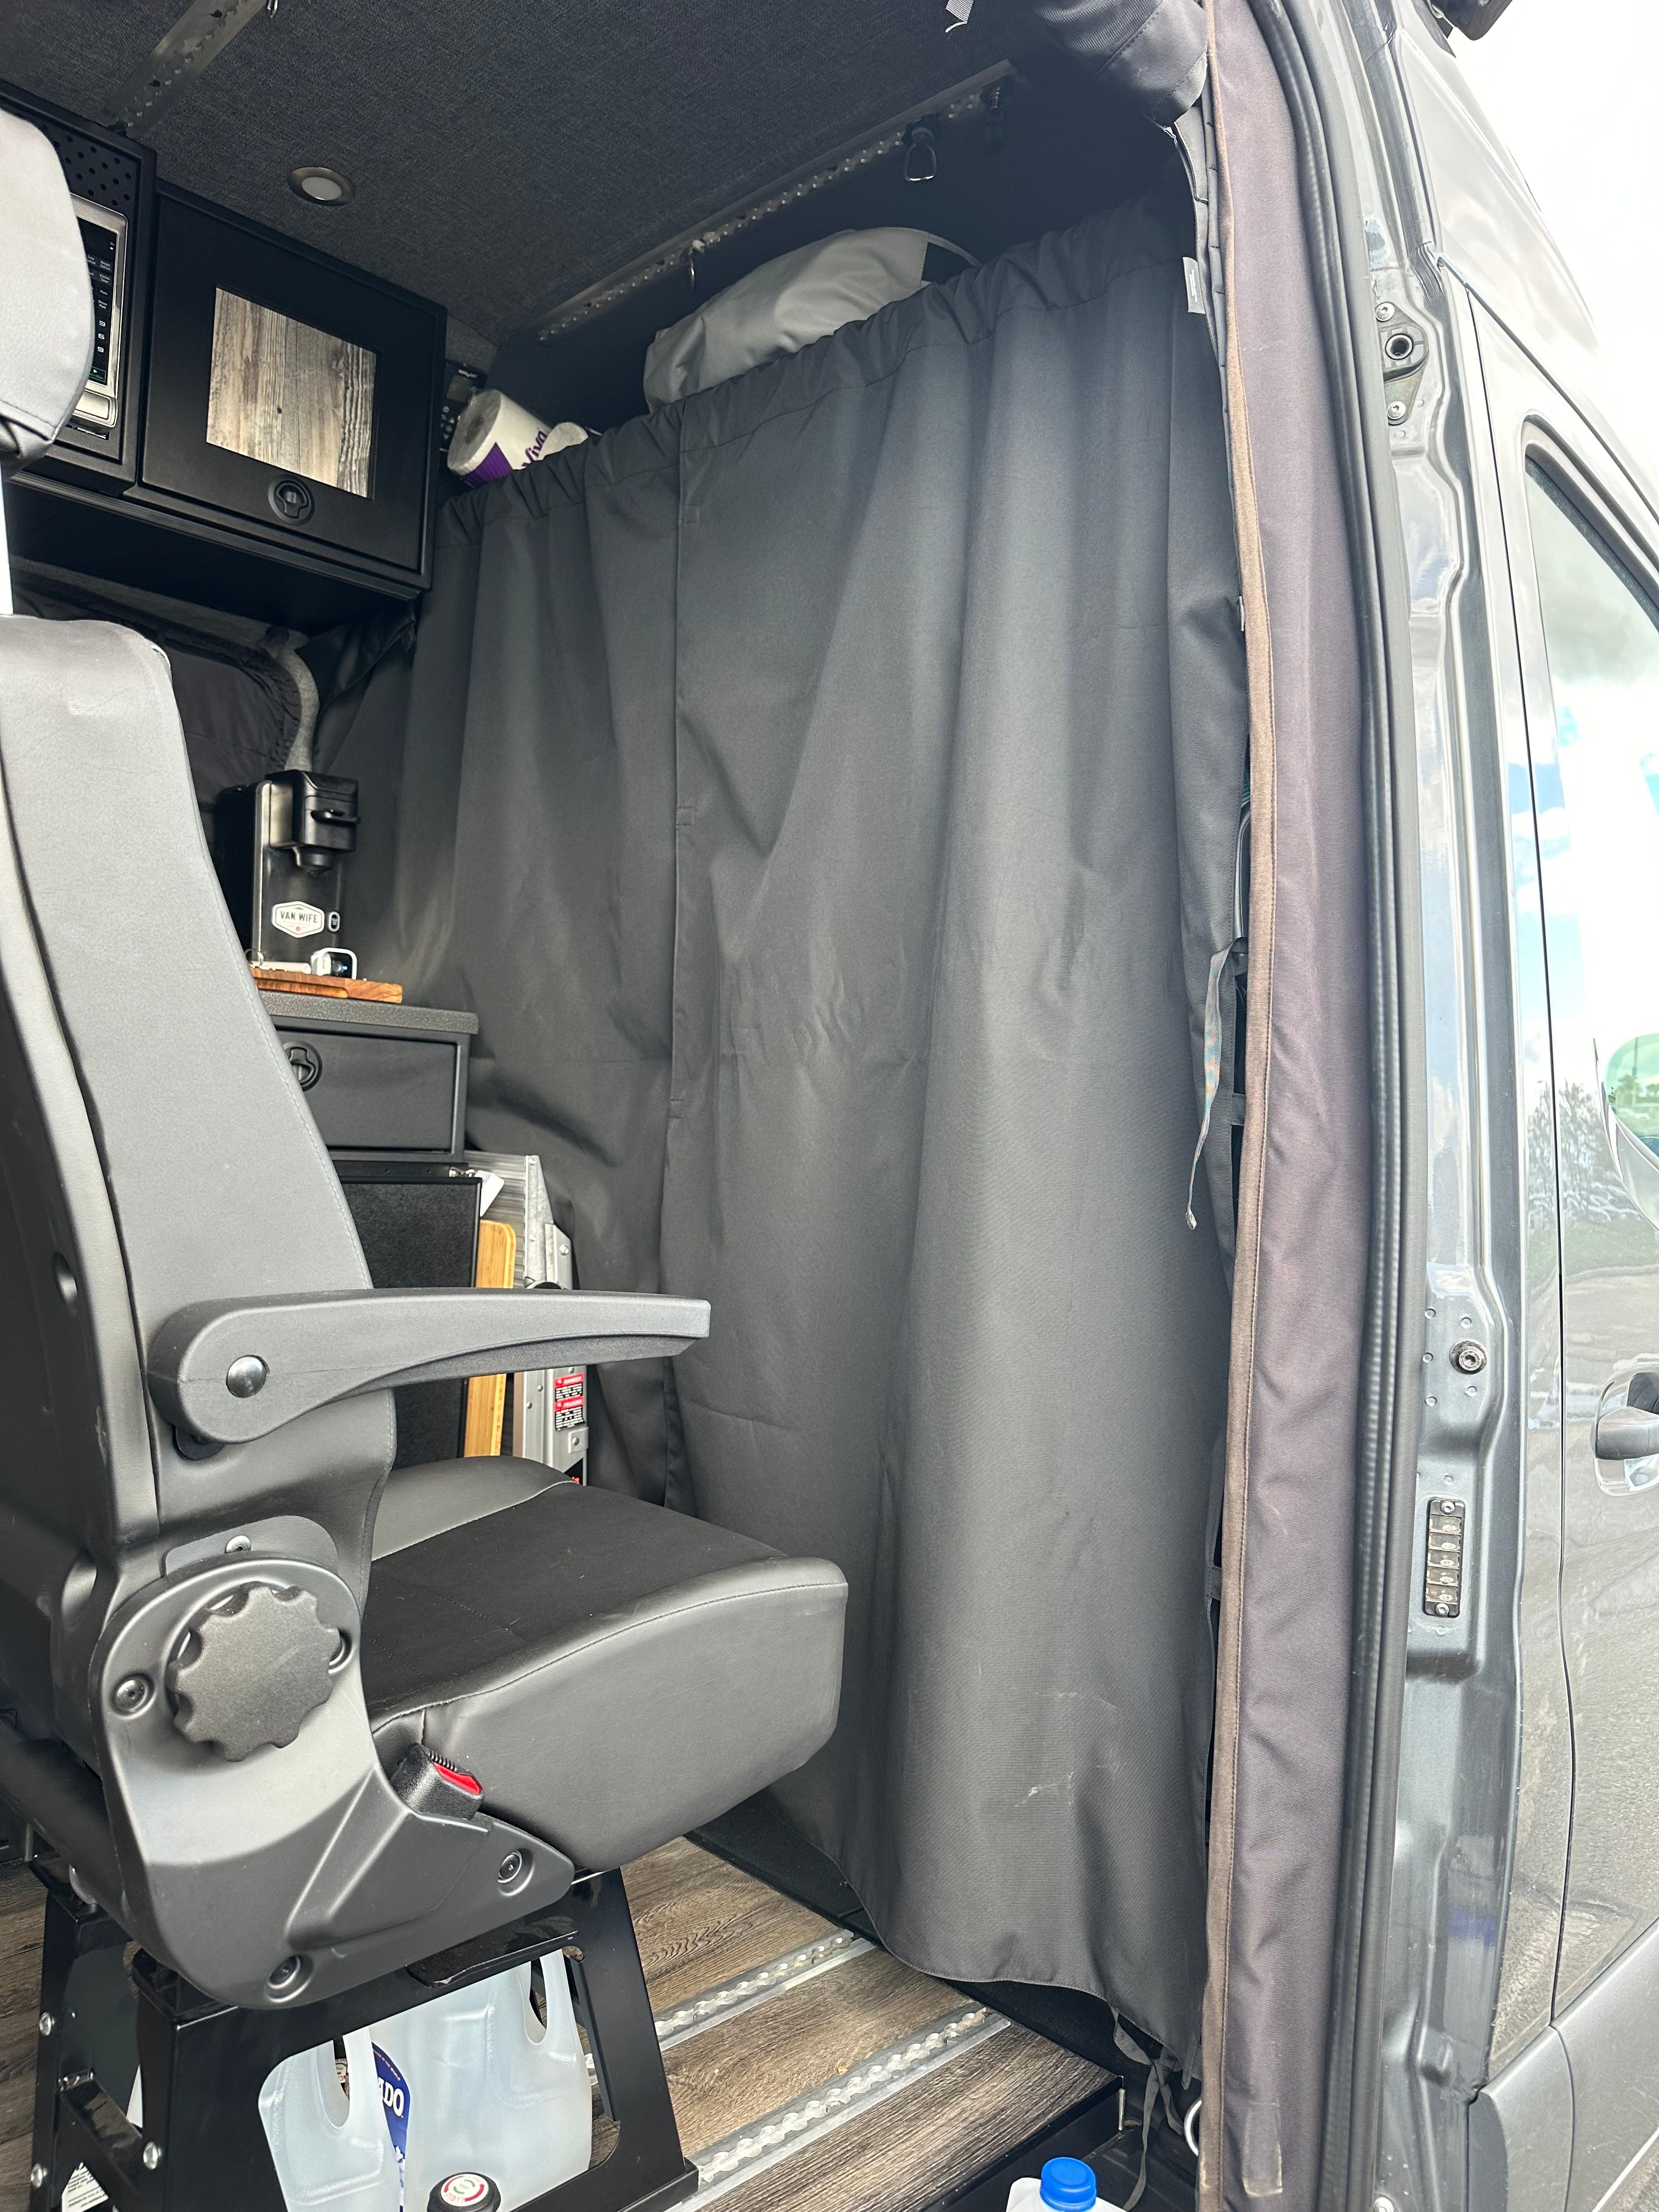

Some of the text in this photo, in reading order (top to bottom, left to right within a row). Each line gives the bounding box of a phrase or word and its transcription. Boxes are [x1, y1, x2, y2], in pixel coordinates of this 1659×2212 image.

[280, 910, 296, 921] VAN
[298, 912, 318, 923] WIFE
[390, 2067, 400, 2081] WORLD
